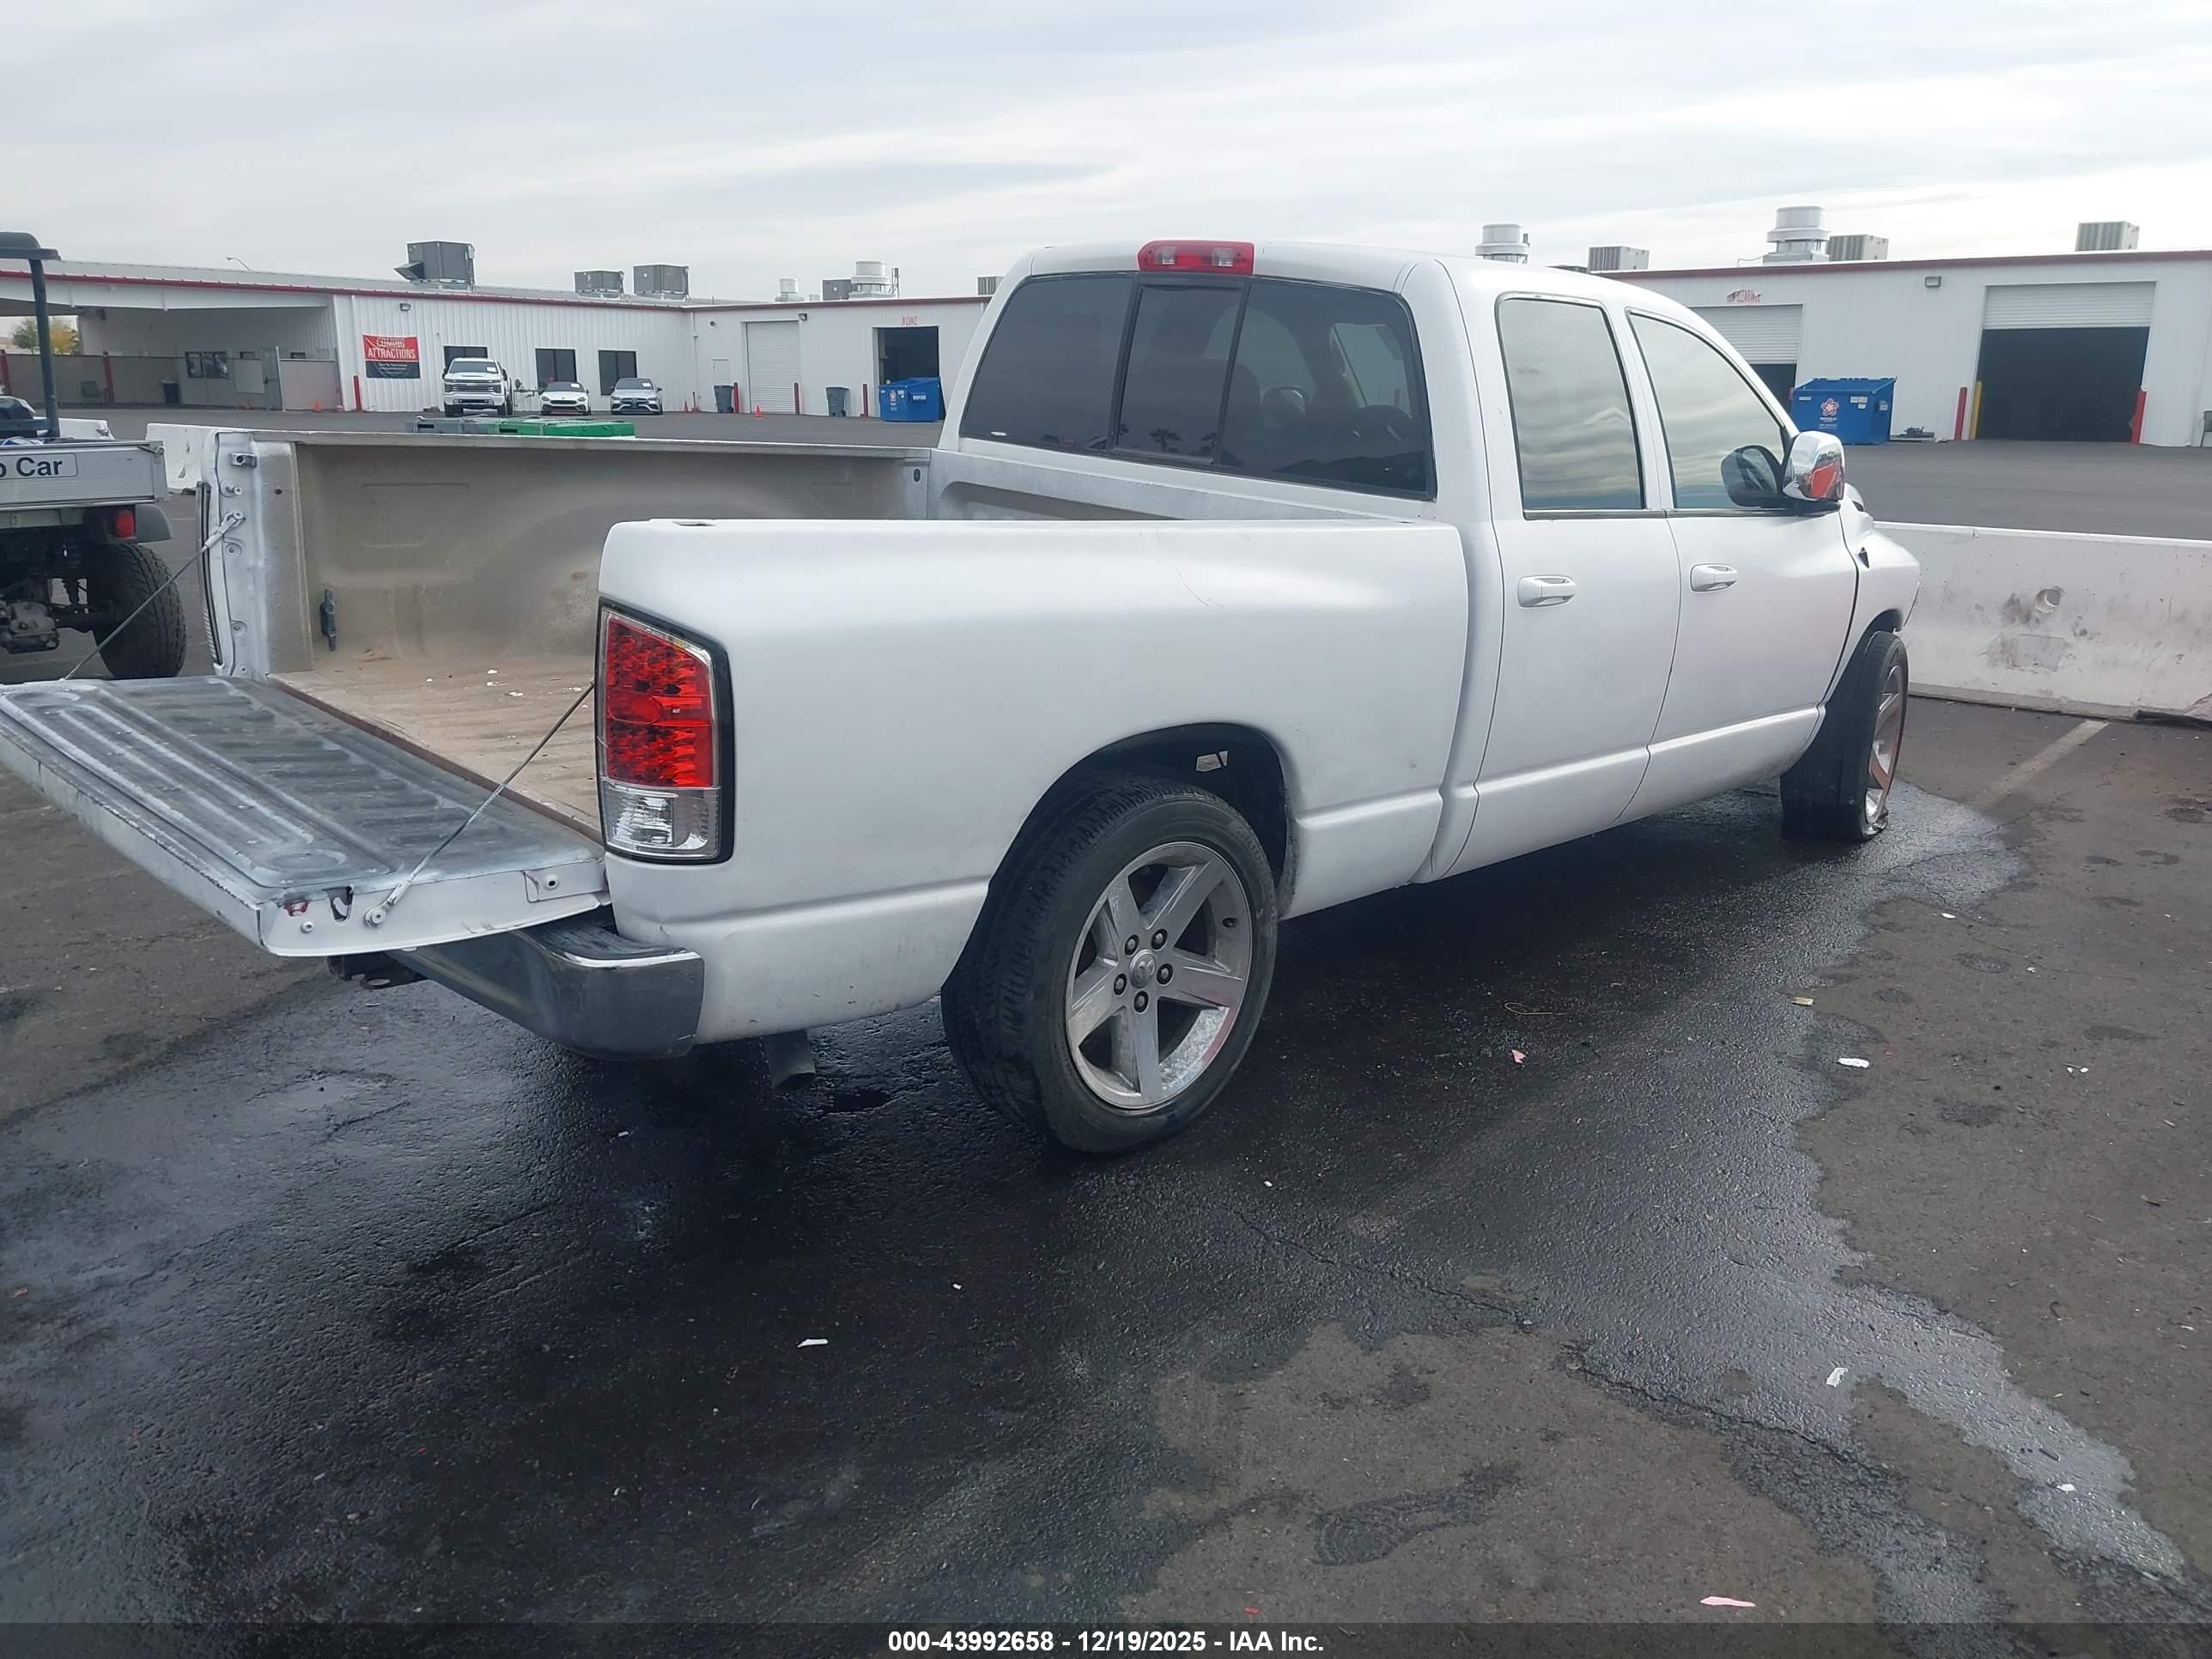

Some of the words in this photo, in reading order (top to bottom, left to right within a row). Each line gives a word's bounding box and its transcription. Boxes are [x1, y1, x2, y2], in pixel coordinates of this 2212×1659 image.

[376, 337, 405, 349] COMING
[368, 348, 416, 359] ATTRACTIONS
[15, 456, 63, 477] Car
